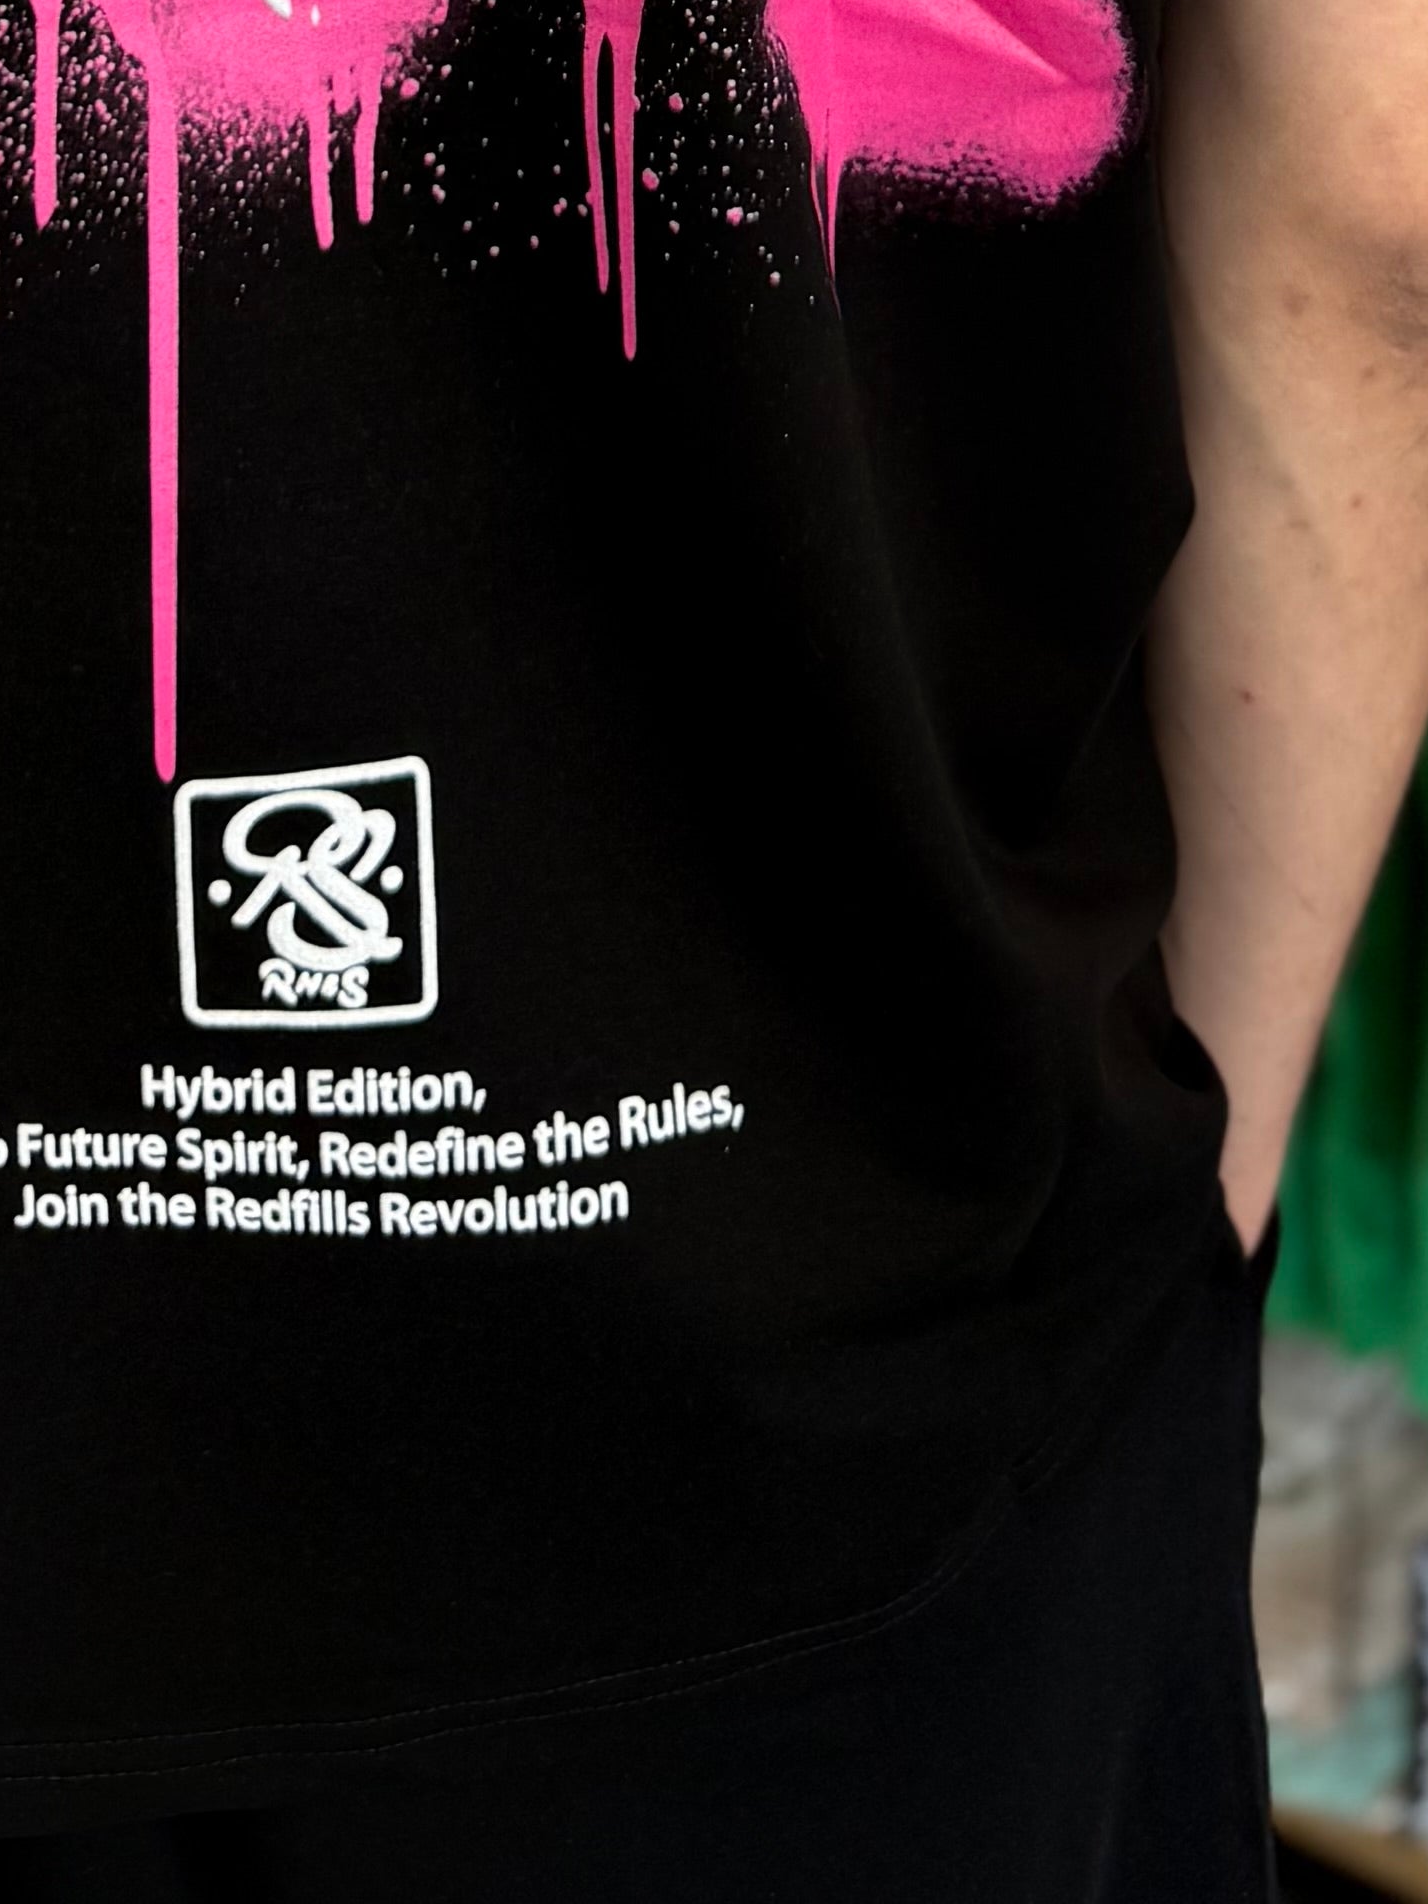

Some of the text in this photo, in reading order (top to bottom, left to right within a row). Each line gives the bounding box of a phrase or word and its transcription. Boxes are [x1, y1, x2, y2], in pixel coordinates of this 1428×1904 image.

[140, 1063, 487, 1120] Hybrid Edition,
[16, 1122, 168, 1169] Future
[175, 1127, 310, 1182] Spirit,
[319, 1125, 526, 1179] Redefine
[532, 1110, 611, 1166] the
[618, 1082, 745, 1149] Rules,
[13, 1180, 629, 1236] Join the Redfills Revolution
